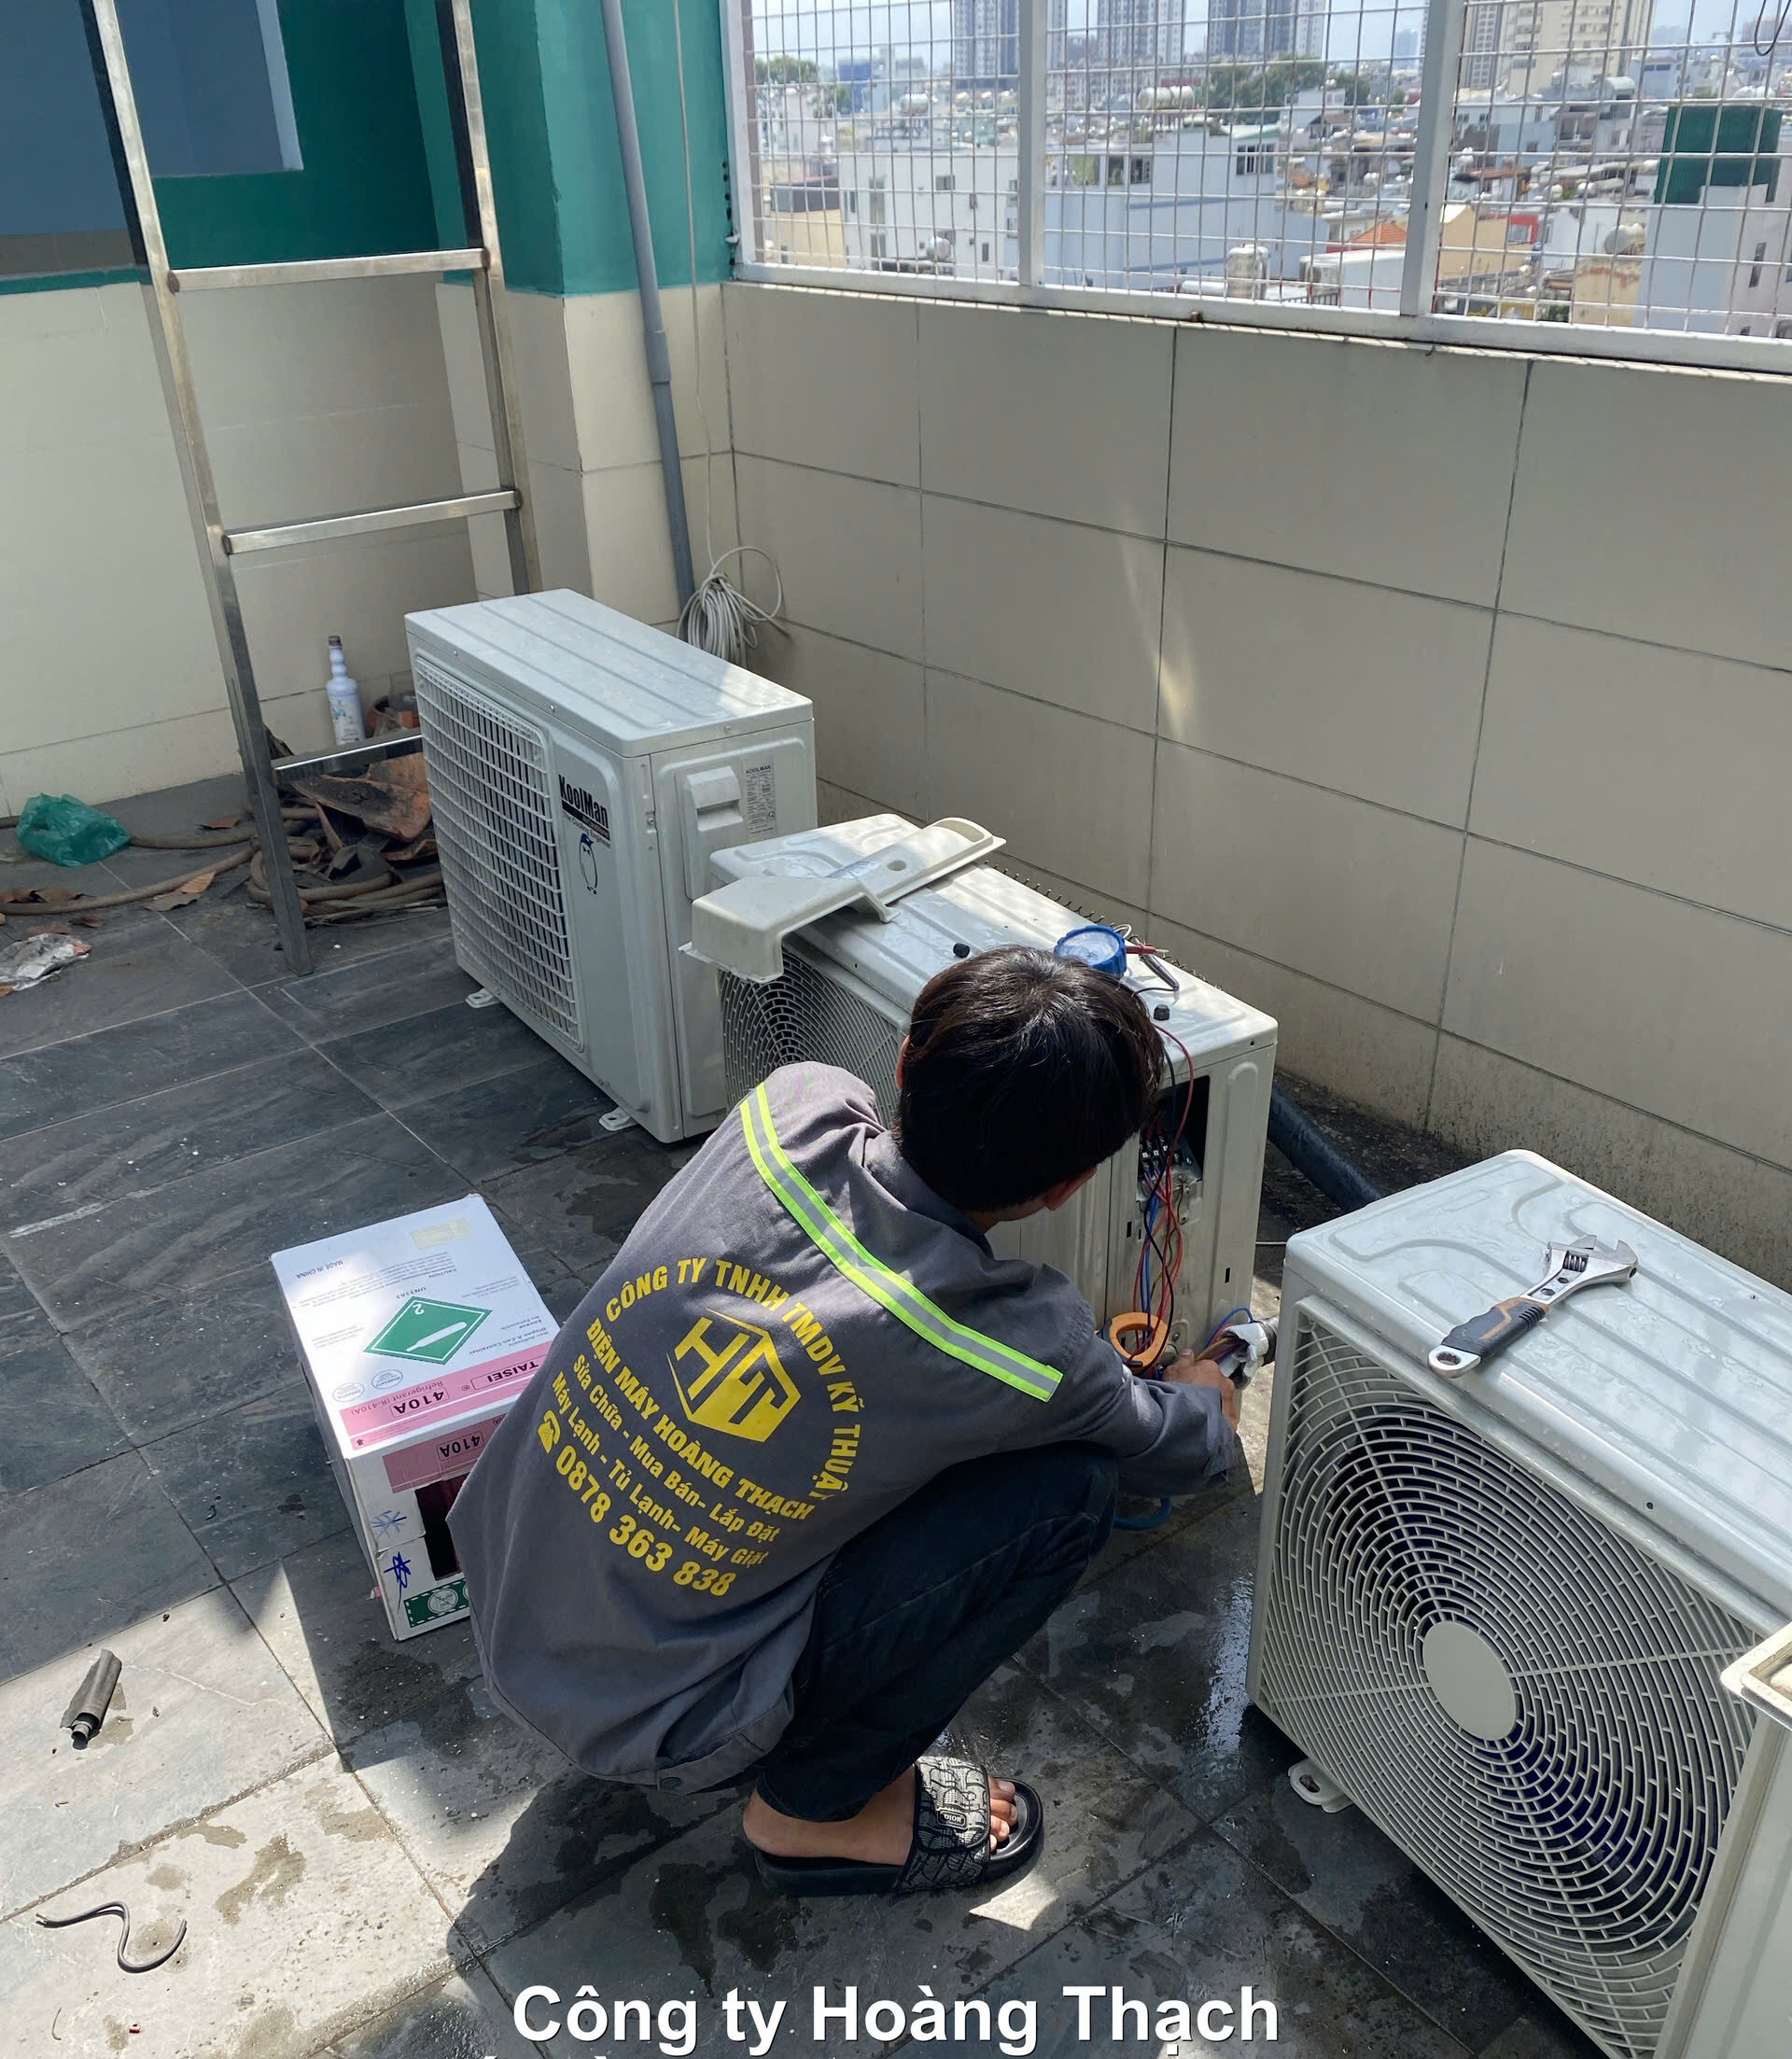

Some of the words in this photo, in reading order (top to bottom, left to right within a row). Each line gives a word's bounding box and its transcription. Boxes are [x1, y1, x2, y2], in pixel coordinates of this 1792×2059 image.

[558, 774, 609, 829] KoolMan
[296, 1268, 316, 1280] CHINA
[325, 1260, 343, 1269] MADE
[428, 1268, 456, 1279] CAUTION
[413, 1304, 425, 1315] 2
[605, 1265, 668, 1322] CÔNG
[677, 1257, 707, 1284] TY
[716, 1259, 791, 1312] TNHH
[781, 1301, 847, 1376] TMDV
[827, 1380, 865, 1413] KỸ
[487, 1361, 539, 1382] TAISEI
[393, 1381, 443, 1400] Refrigerant
[351, 1400, 390, 1415] (R-410A)
[393, 1391, 444, 1414] 410A
[586, 1317, 621, 1374] ĐIỆN
[614, 1370, 659, 1420] MÁY
[653, 1413, 735, 1489] HOÀNG
[735, 1478, 817, 1520] THẠCH
[439, 1436, 481, 1457] 410A
[573, 1353, 593, 1390] Sửa
[589, 1383, 623, 1431] Chữa
[629, 1436, 665, 1478] Mua
[708, 1502, 746, 1533] Lắp
[746, 1521, 781, 1543] Đặt
[552, 1370, 572, 1416] Máy
[567, 1407, 600, 1456] Lạnh
[609, 1459, 633, 1492] Tủ
[684, 1526, 730, 1562] Máy
[732, 1548, 769, 1569] Giặt
[556, 1445, 613, 1524] 0878
[609, 1514, 675, 1573] 363
[673, 1560, 737, 1597] 838
[944, 1814, 961, 1823] DIOR
